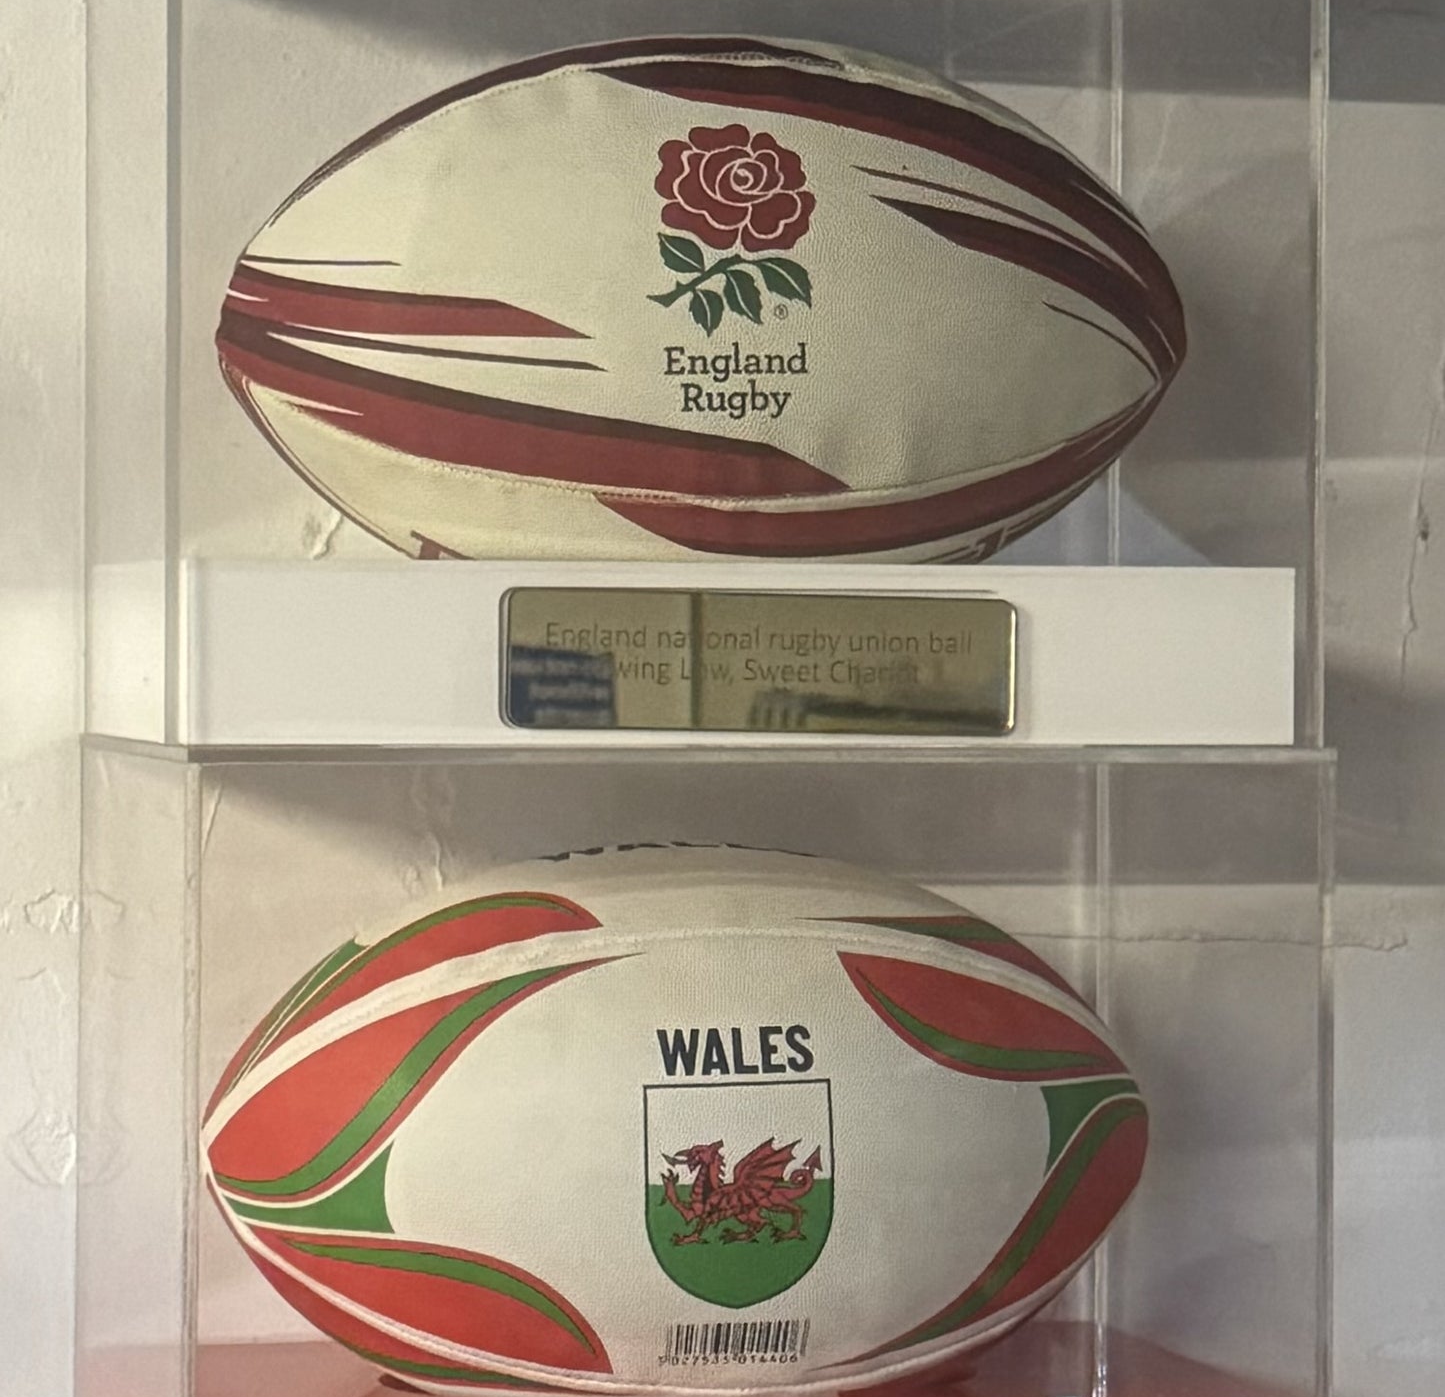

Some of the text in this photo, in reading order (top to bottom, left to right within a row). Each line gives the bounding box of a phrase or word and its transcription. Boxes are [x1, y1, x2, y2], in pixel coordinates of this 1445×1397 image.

[664, 343, 808, 383] England
[681, 380, 791, 419] Rugby
[546, 622, 972, 656] England naonal rugby union ball
[610, 656, 671, 685] wing
[744, 658, 821, 684] Sweet
[657, 1024, 814, 1076] WALES
